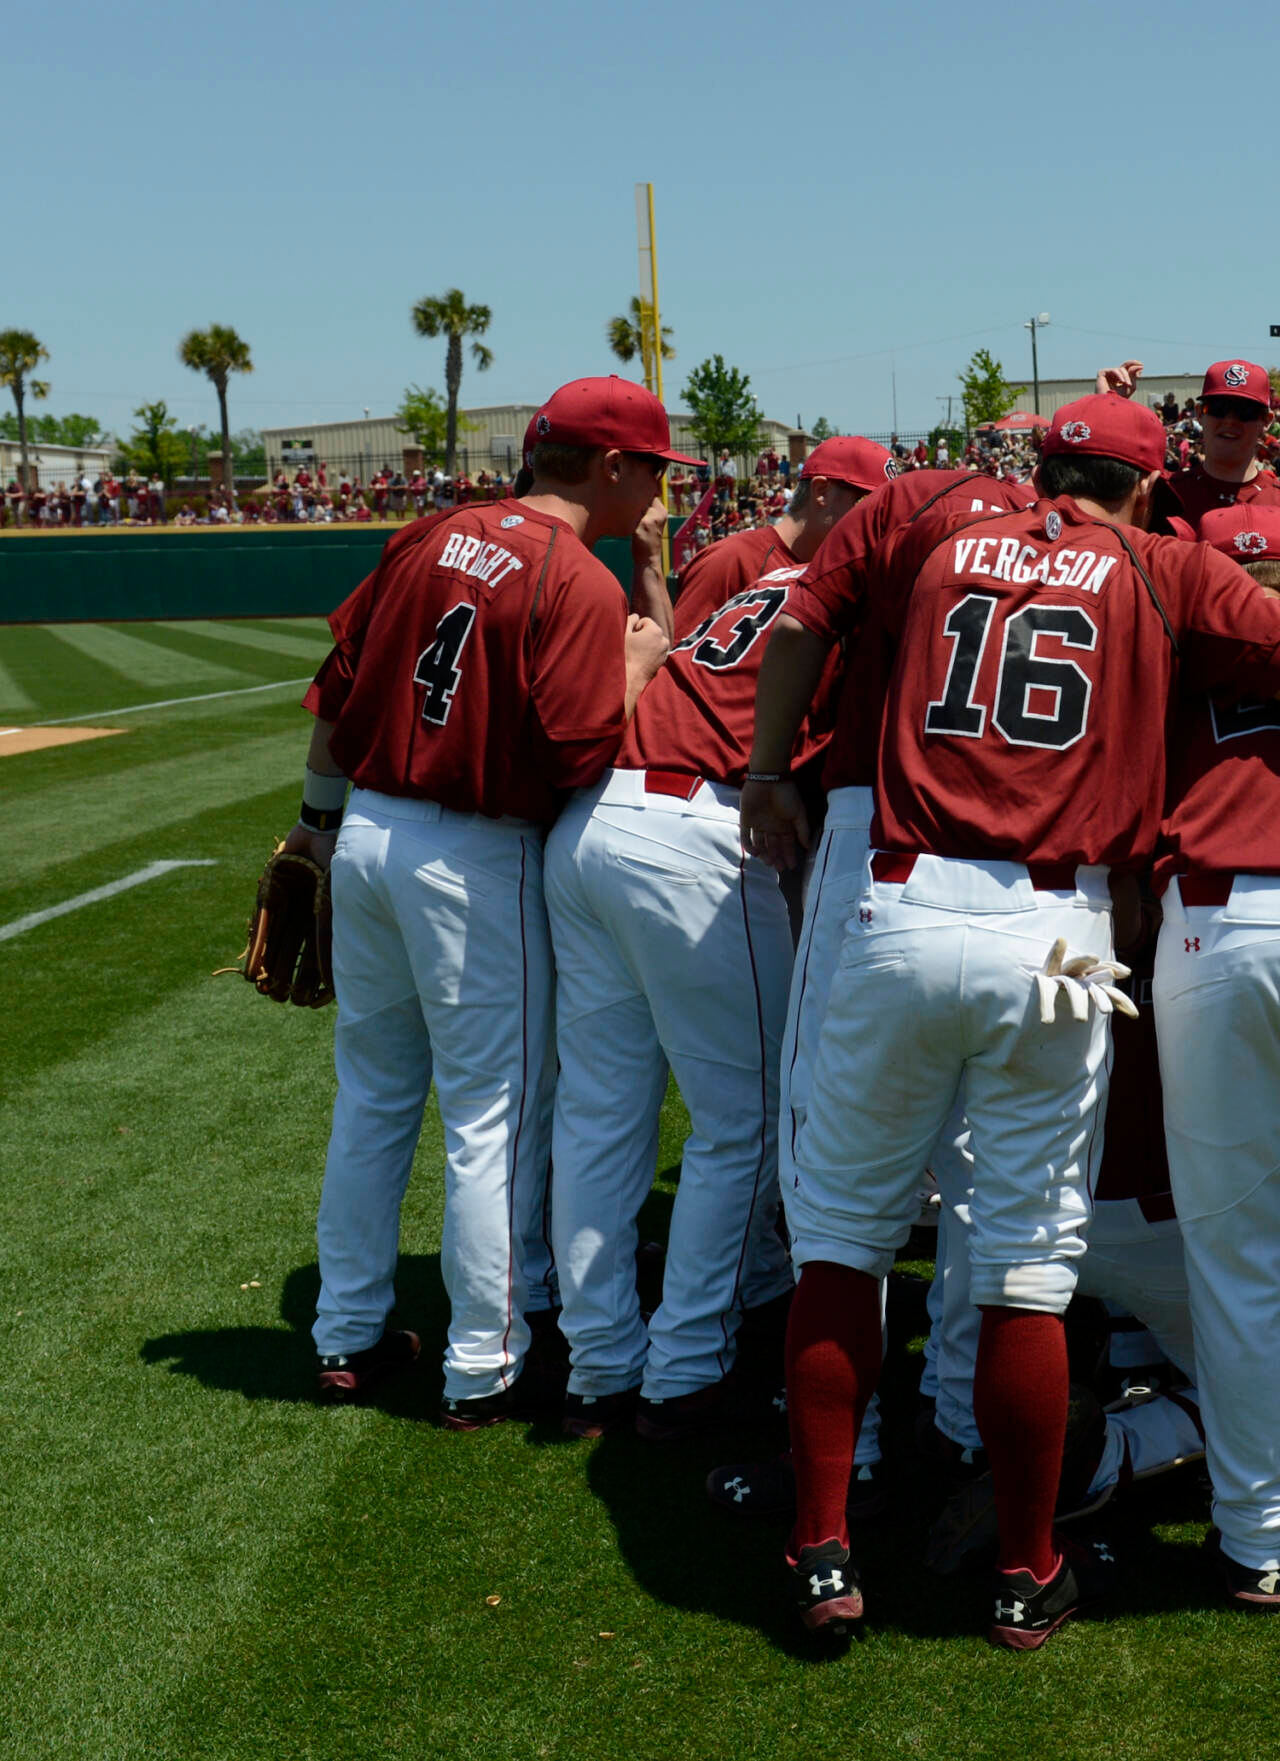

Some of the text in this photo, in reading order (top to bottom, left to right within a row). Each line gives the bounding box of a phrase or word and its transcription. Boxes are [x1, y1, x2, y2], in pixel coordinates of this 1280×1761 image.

[437, 532, 524, 588] BRIGHT
[954, 537, 1118, 594] VERGASON
[413, 601, 476, 726] 4
[924, 593, 1098, 751] 16
